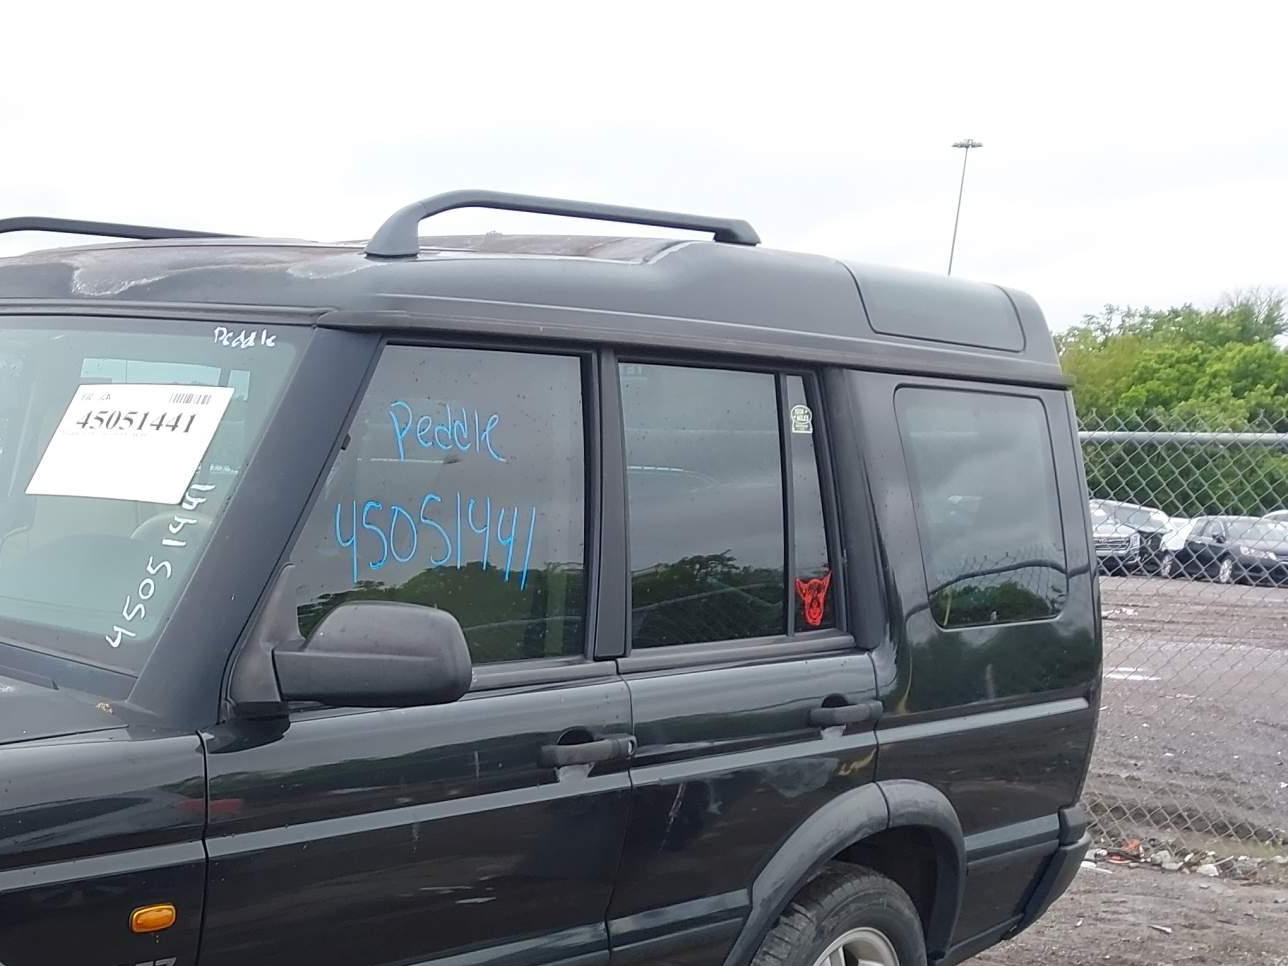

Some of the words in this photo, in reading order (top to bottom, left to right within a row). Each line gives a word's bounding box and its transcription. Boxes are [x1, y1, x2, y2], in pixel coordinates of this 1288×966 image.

[76, 410, 197, 433] 45051441
[105, 483, 216, 648] 45051441
[335, 491, 537, 592] 45051441
